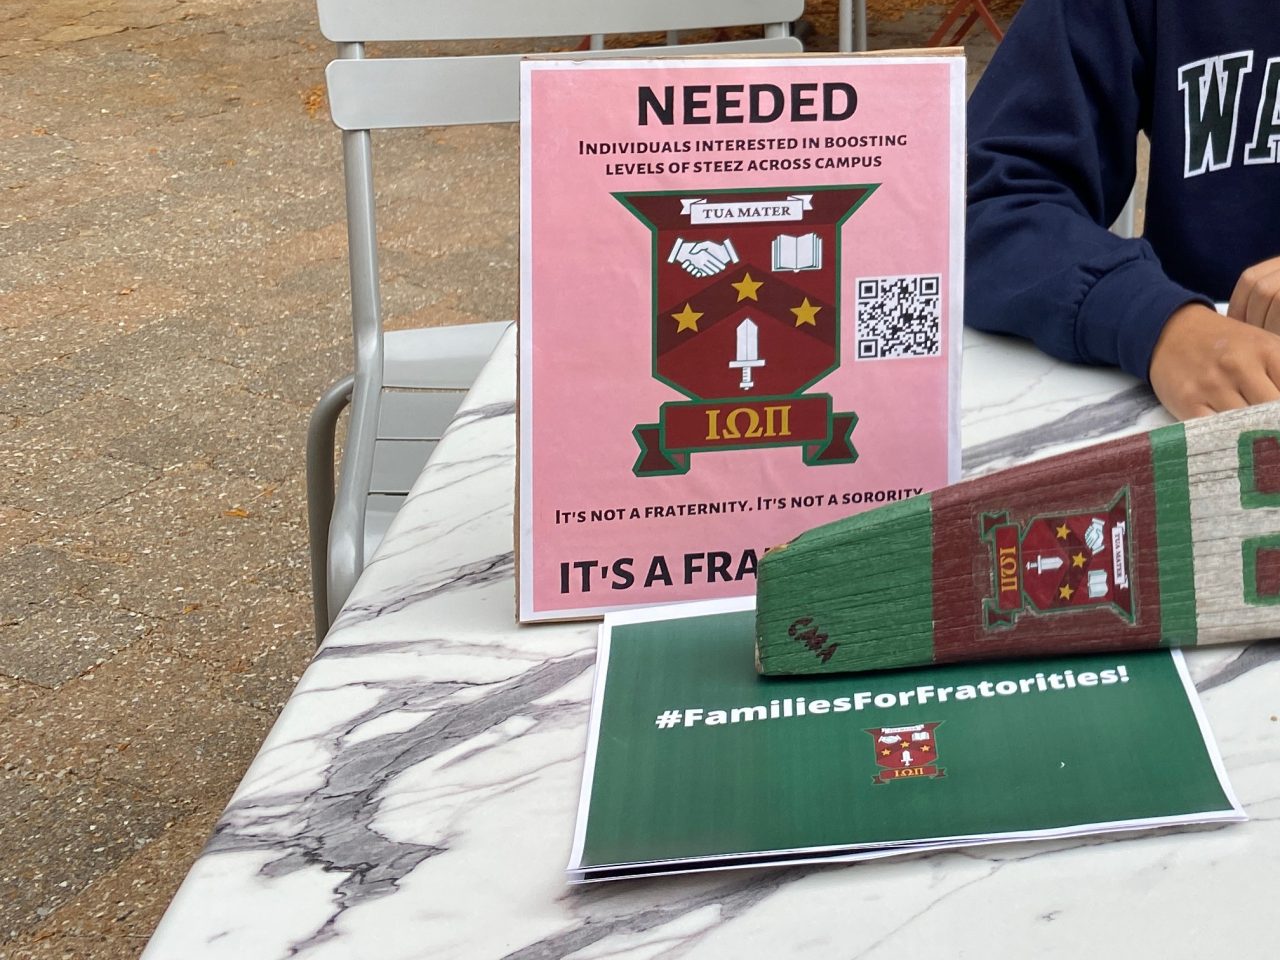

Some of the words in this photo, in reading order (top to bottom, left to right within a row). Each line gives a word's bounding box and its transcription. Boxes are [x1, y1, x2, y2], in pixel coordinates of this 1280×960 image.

[638, 81, 858, 126] NEEDED
[696, 136, 798, 152] INTERESTED
[802, 136, 820, 149] IN
[825, 134, 908, 149] BOOSTING
[605, 161, 665, 176] LEVELS
[669, 160, 690, 173] OF
[694, 158, 743, 173] STEEZ
[747, 156, 811, 171] ACROSS
[815, 155, 882, 169] CAMPUS
[702, 207, 734, 220] TUA
[738, 205, 791, 218] MATER
[590, 509, 626, 521] NOT
[629, 507, 640, 519] A
[644, 499, 753, 518] FRATERNITY.
[790, 495, 825, 508] NOT
[828, 494, 838, 506] A
[560, 557, 635, 594] IT'S
[644, 555, 673, 588] A
[684, 548, 770, 584] FRA
[1114, 553, 1122, 578] MATER
[656, 665, 1130, 730] #FamiliesForFratorities!
